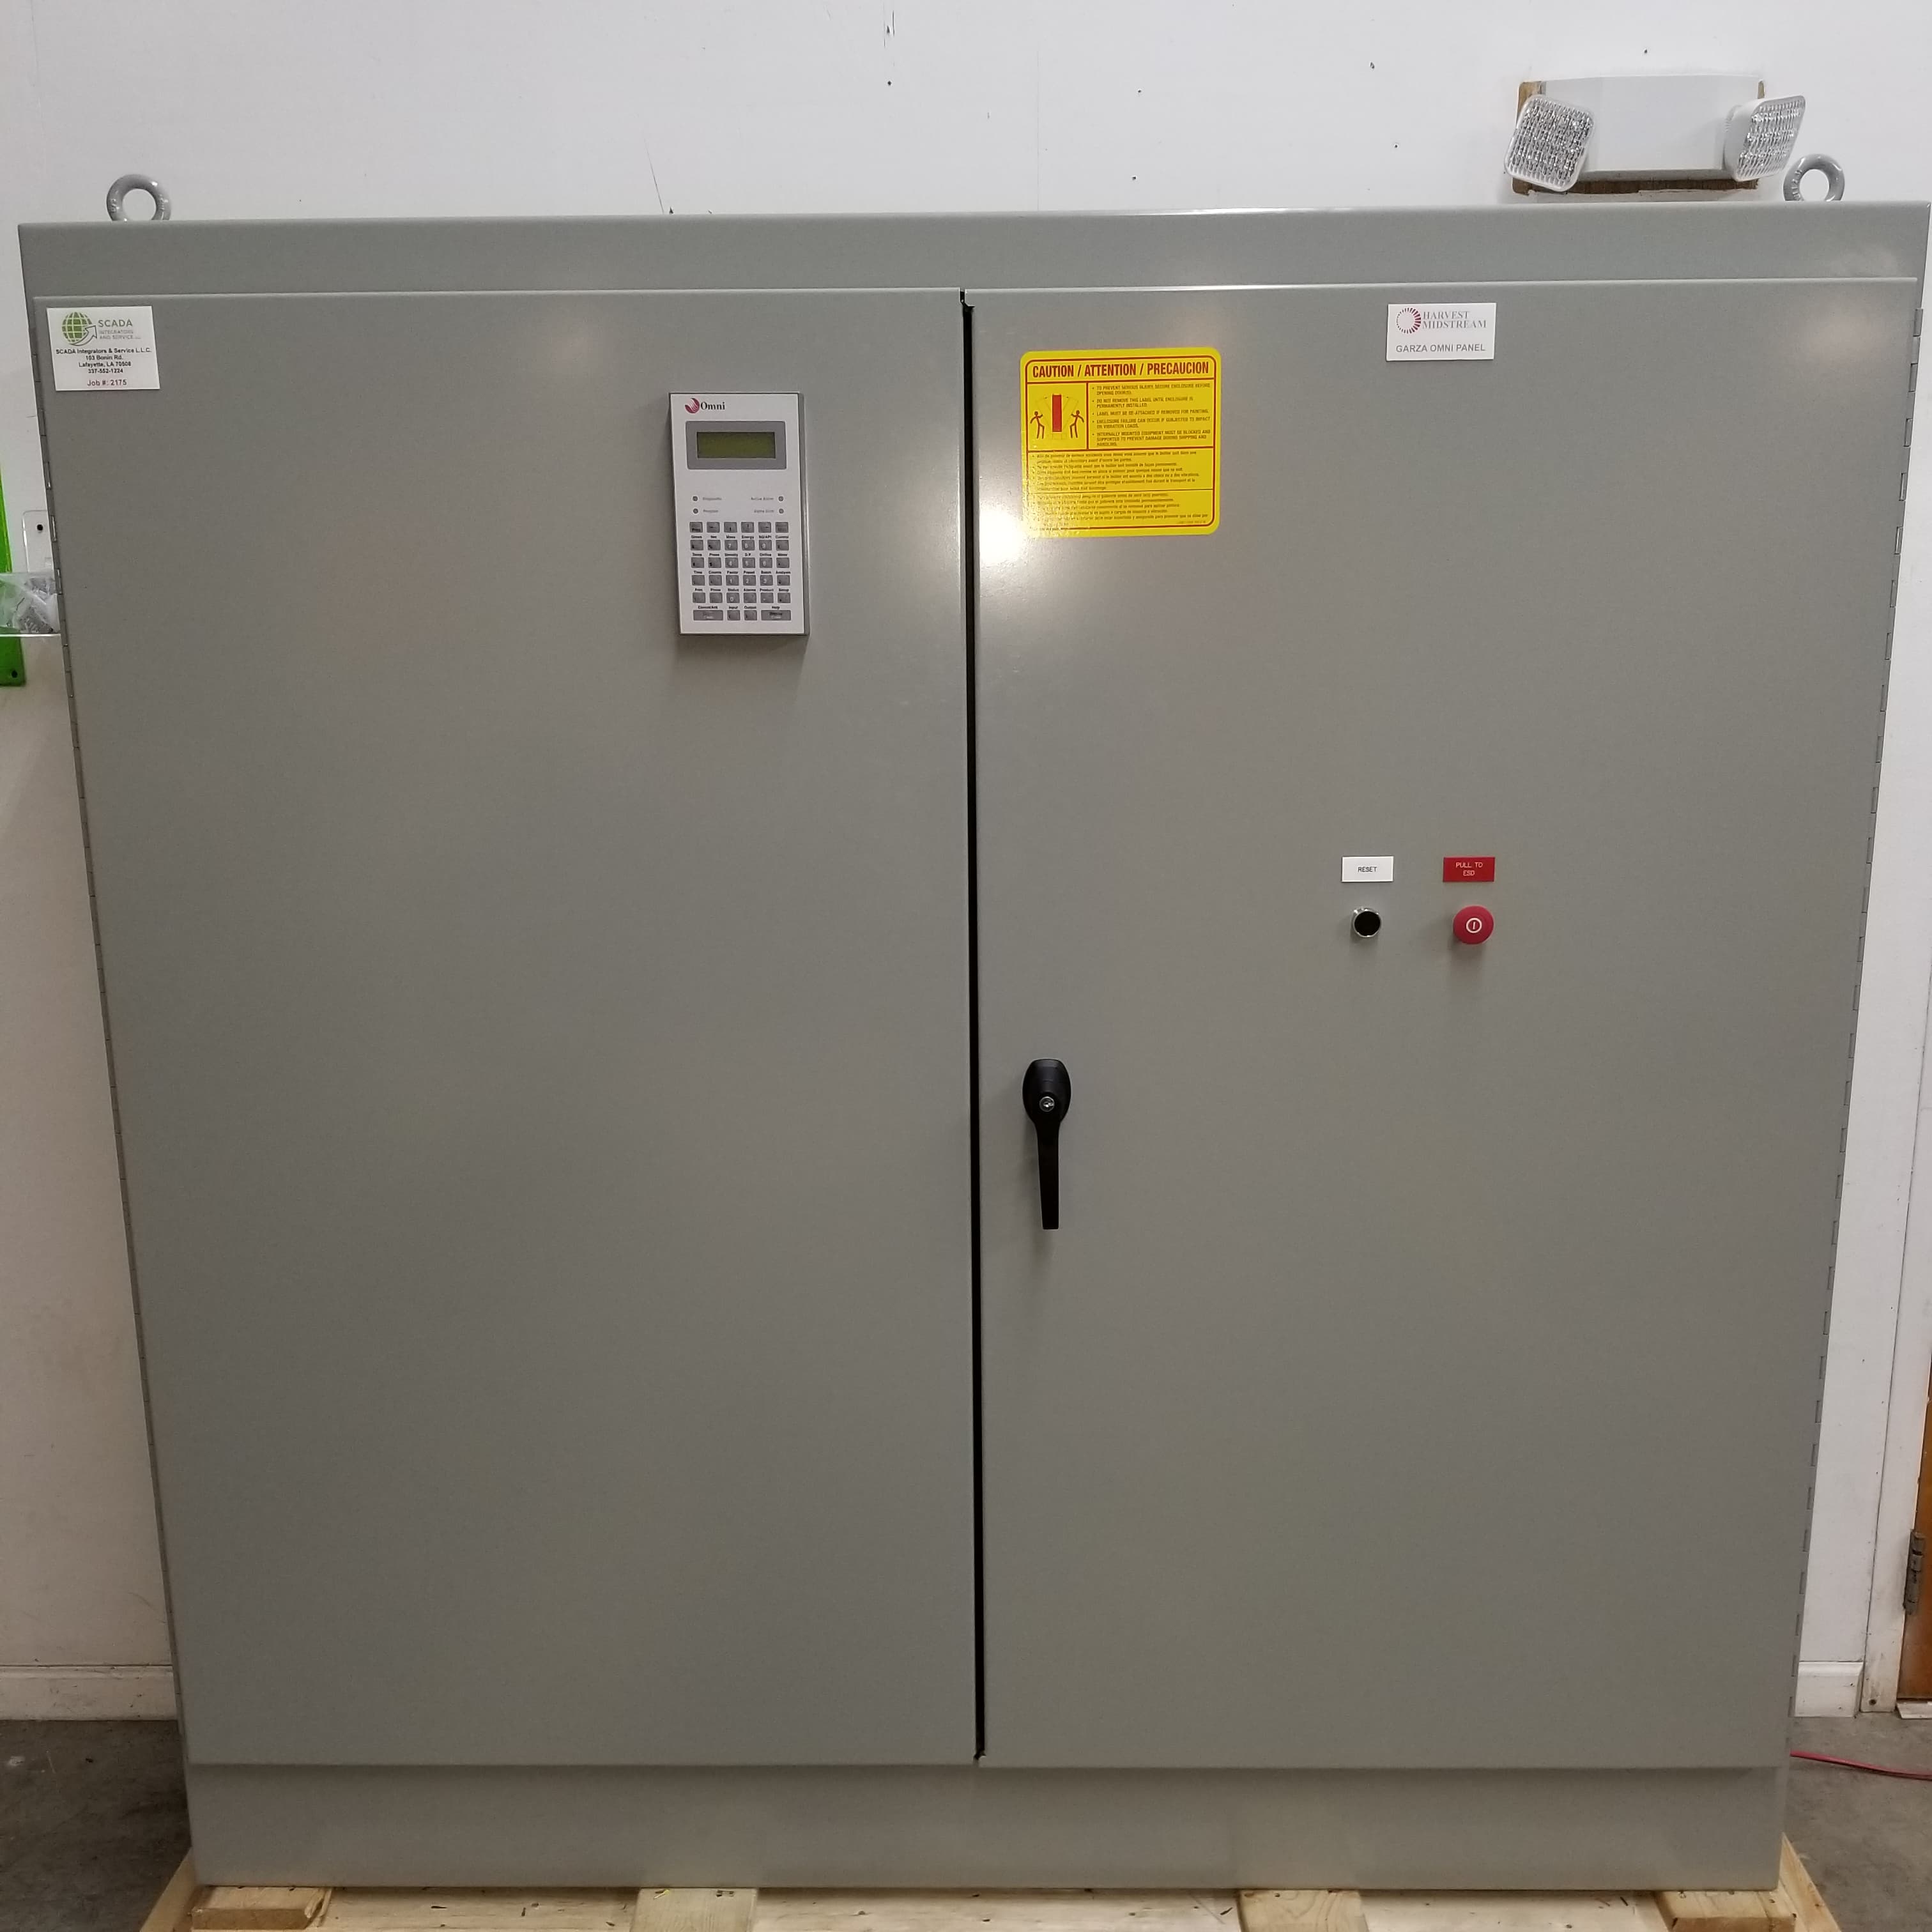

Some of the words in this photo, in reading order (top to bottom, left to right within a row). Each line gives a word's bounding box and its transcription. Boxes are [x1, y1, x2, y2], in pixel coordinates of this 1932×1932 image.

[1423, 310, 1469, 319] HARVEST
[98, 319, 133, 327] SCADA
[1422, 320, 1486, 329] MIDSTREAM
[1032, 365, 1074, 378] CAUTION
[1077, 365, 1082, 377] /
[1084, 363, 1136, 376] ATTENTION
[1139, 363, 1144, 376] /
[1147, 362, 1209, 375] PRECAUCION
[700, 401, 726, 410] Omni
